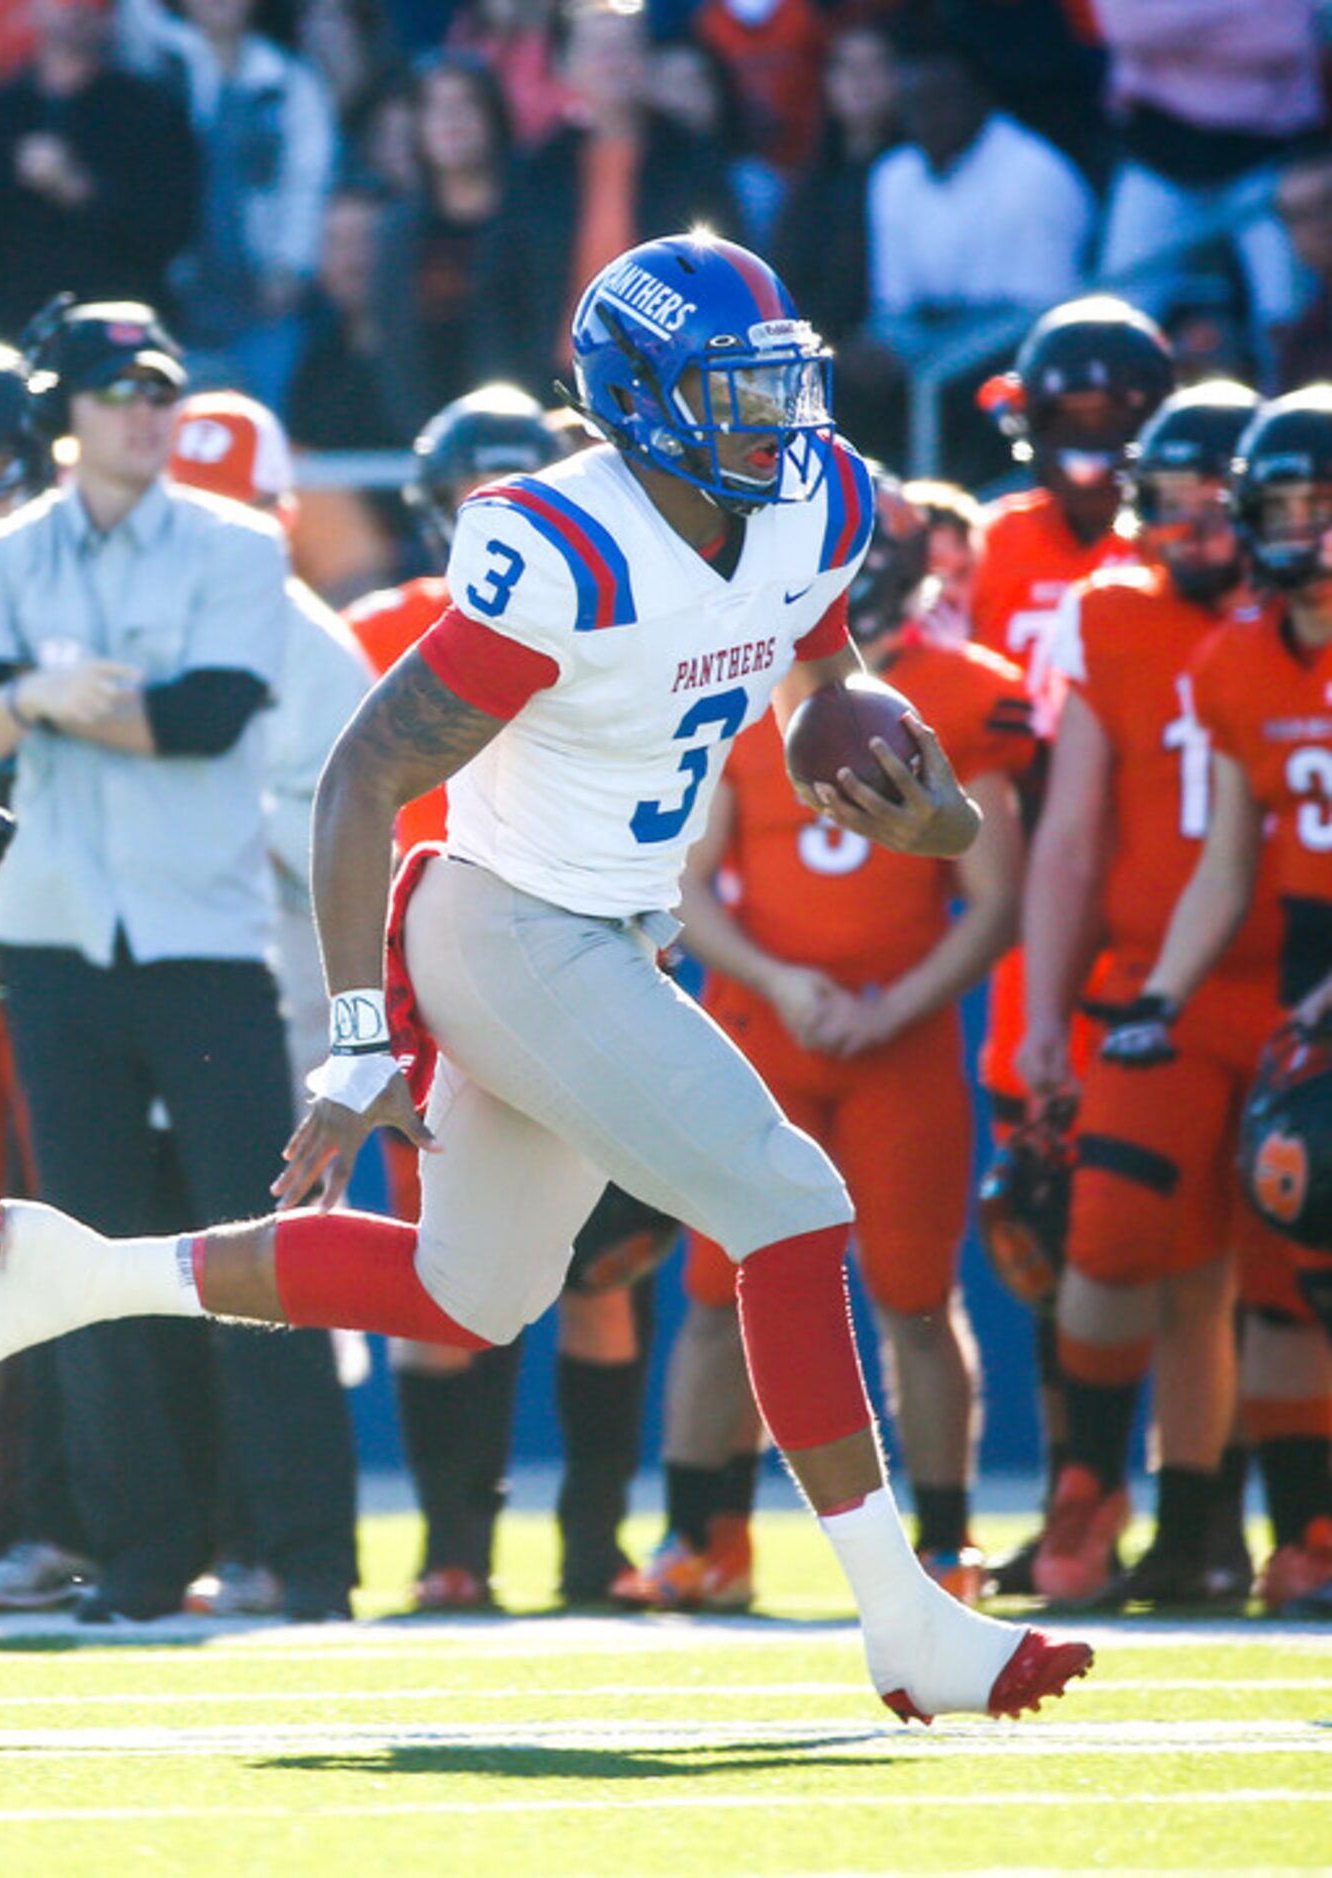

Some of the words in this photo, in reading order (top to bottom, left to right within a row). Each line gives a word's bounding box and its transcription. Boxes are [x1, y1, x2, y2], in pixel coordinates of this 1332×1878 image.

[466, 538, 526, 618] 3
[671, 636, 777, 694] PANTHERS
[629, 686, 750, 844] 3
